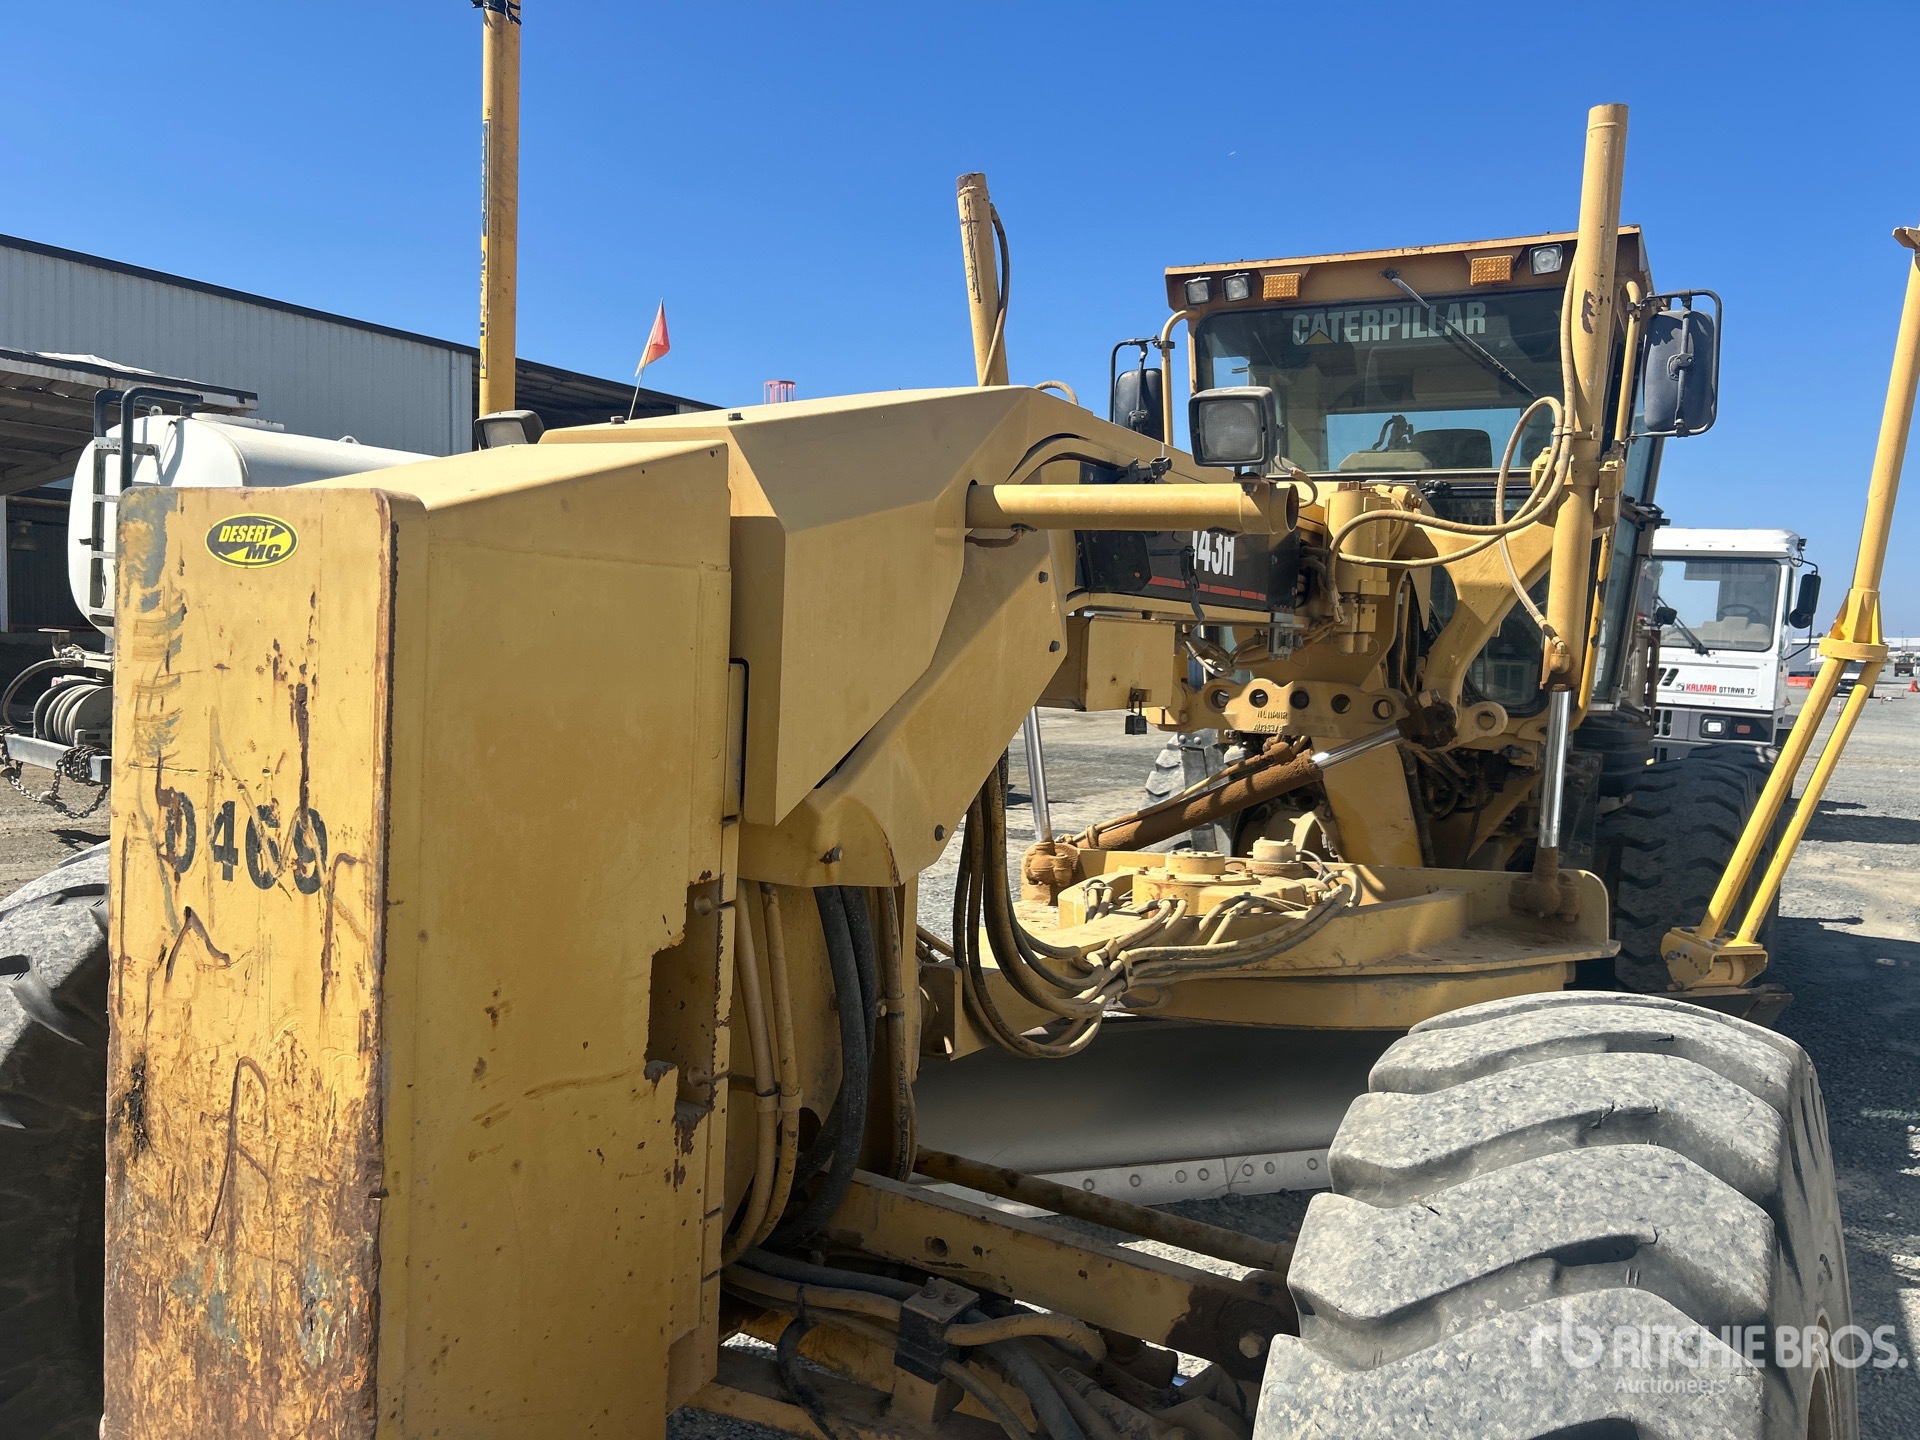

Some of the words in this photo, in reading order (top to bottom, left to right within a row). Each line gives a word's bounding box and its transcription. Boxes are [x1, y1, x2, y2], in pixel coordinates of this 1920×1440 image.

[1292, 302, 1486, 346] CATERPILLAR
[218, 525, 275, 543] DESERT
[244, 543, 282, 561] MC
[1685, 683, 1717, 693] KALMAR
[1718, 686, 1745, 694] OTTAWA
